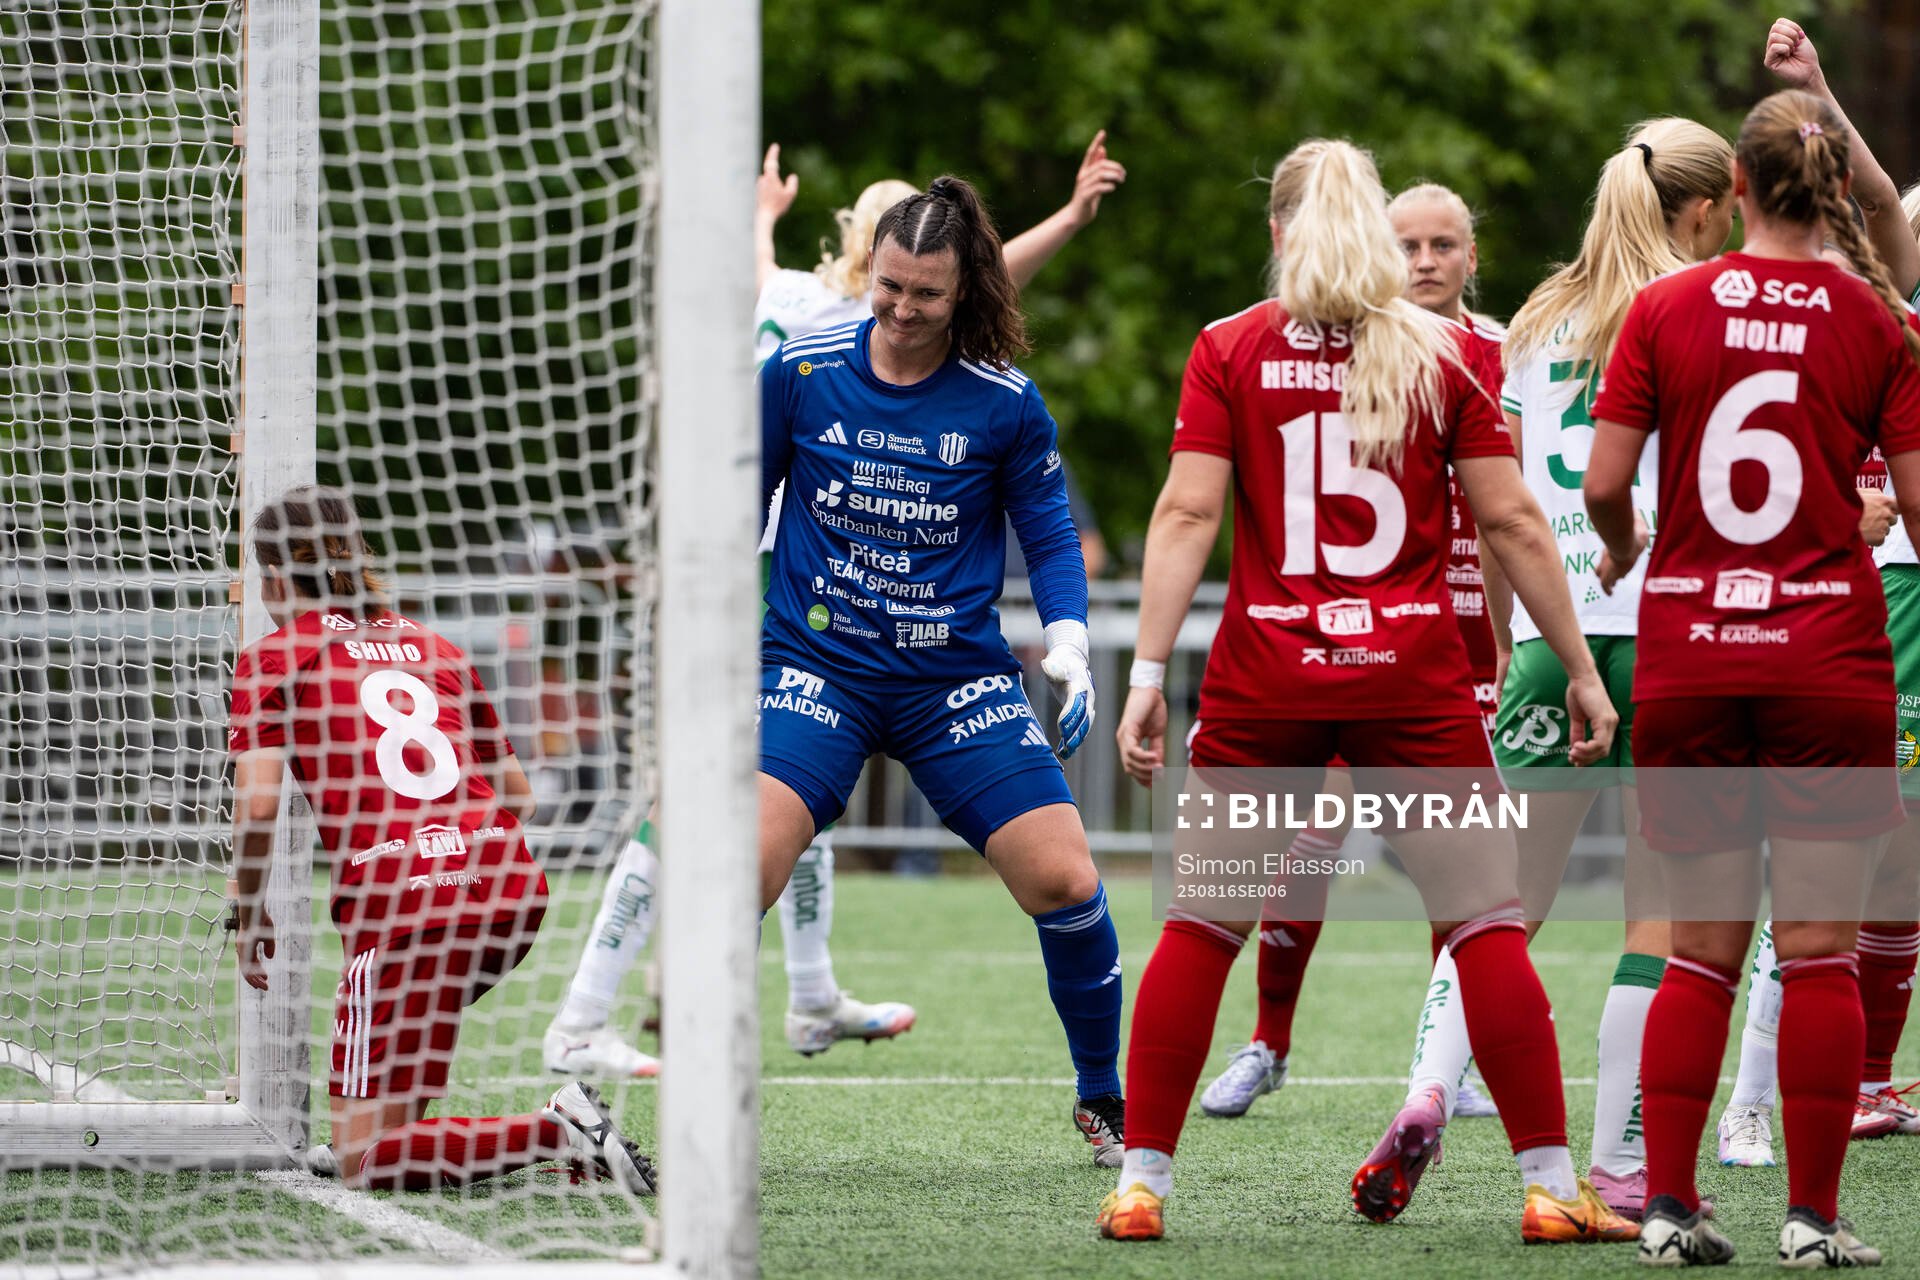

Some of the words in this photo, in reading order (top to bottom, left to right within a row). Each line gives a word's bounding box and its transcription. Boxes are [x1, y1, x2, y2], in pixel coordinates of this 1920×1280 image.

[1761, 278, 1832, 313] SCA
[1724, 317, 1808, 355] HOLM
[1261, 360, 1349, 392] HENSO
[886, 433, 924, 447] Smurfit
[887, 442, 927, 456] Westrock
[877, 463, 906, 480] PITE
[1698, 369, 1803, 545] 6
[876, 476, 931, 494] ENERGI
[1277, 411, 1407, 577] 15
[1867, 474, 1887, 489] PIT
[811, 500, 907, 543] Sparbanken
[913, 526, 959, 546] Nord
[847, 492, 959, 524] sunpine
[848, 541, 911, 574] Piteå
[827, 557, 865, 585] TEAM
[866, 574, 936, 599] SPORTIA
[809, 611, 828, 623] dina
[832, 622, 880, 640] Försäkringar
[833, 612, 851, 624] Dina
[909, 623, 950, 641] JIAB
[344, 640, 421, 662] SHIHO
[1332, 651, 1396, 666] KAIDING
[947, 674, 1013, 709] coop
[763, 692, 840, 729] NÅIDEN
[360, 670, 460, 800] 8
